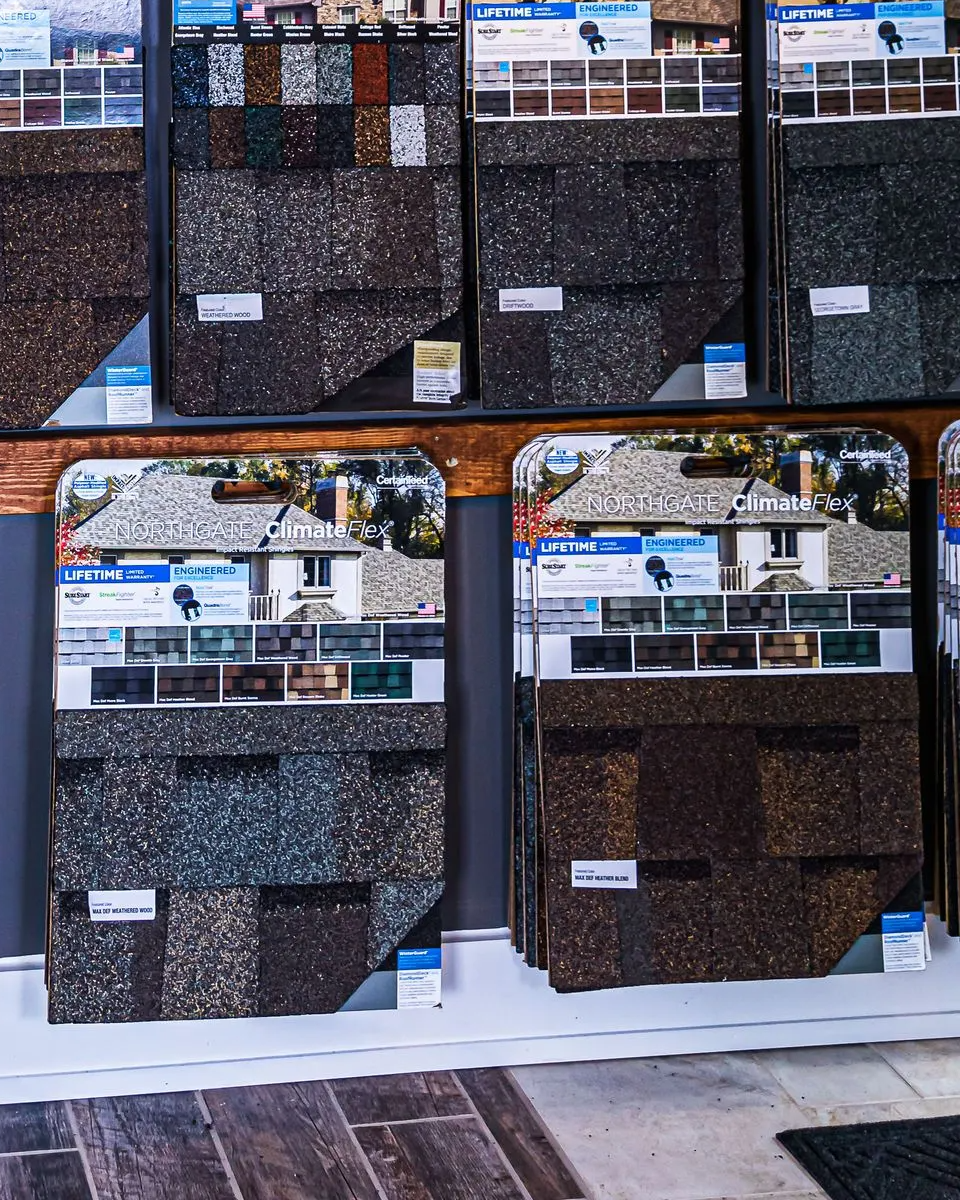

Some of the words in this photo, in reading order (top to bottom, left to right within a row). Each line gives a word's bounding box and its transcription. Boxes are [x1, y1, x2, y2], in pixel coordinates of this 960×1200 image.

[477, 7, 532, 18] LIFETIME
[580, 4, 638, 12] ENGINEERED
[878, 3, 932, 12] ENGINEERED
[782, 8, 834, 20] LIFETIME
[840, 449, 891, 460] CertainTeed
[376, 475, 428, 486] CertainTeed
[587, 494, 720, 514] NORTHGATE
[732, 493, 853, 512] ClimateFlex
[115, 520, 252, 540] NORTHGATE
[266, 520, 389, 539] ClimateFlex
[542, 541, 596, 552] LIFETIME
[646, 539, 705, 547] ENGINEERED
[217, 546, 238, 554] Impact
[65, 570, 123, 581] LIFETIME
[174, 567, 236, 575] ENGINEERED
